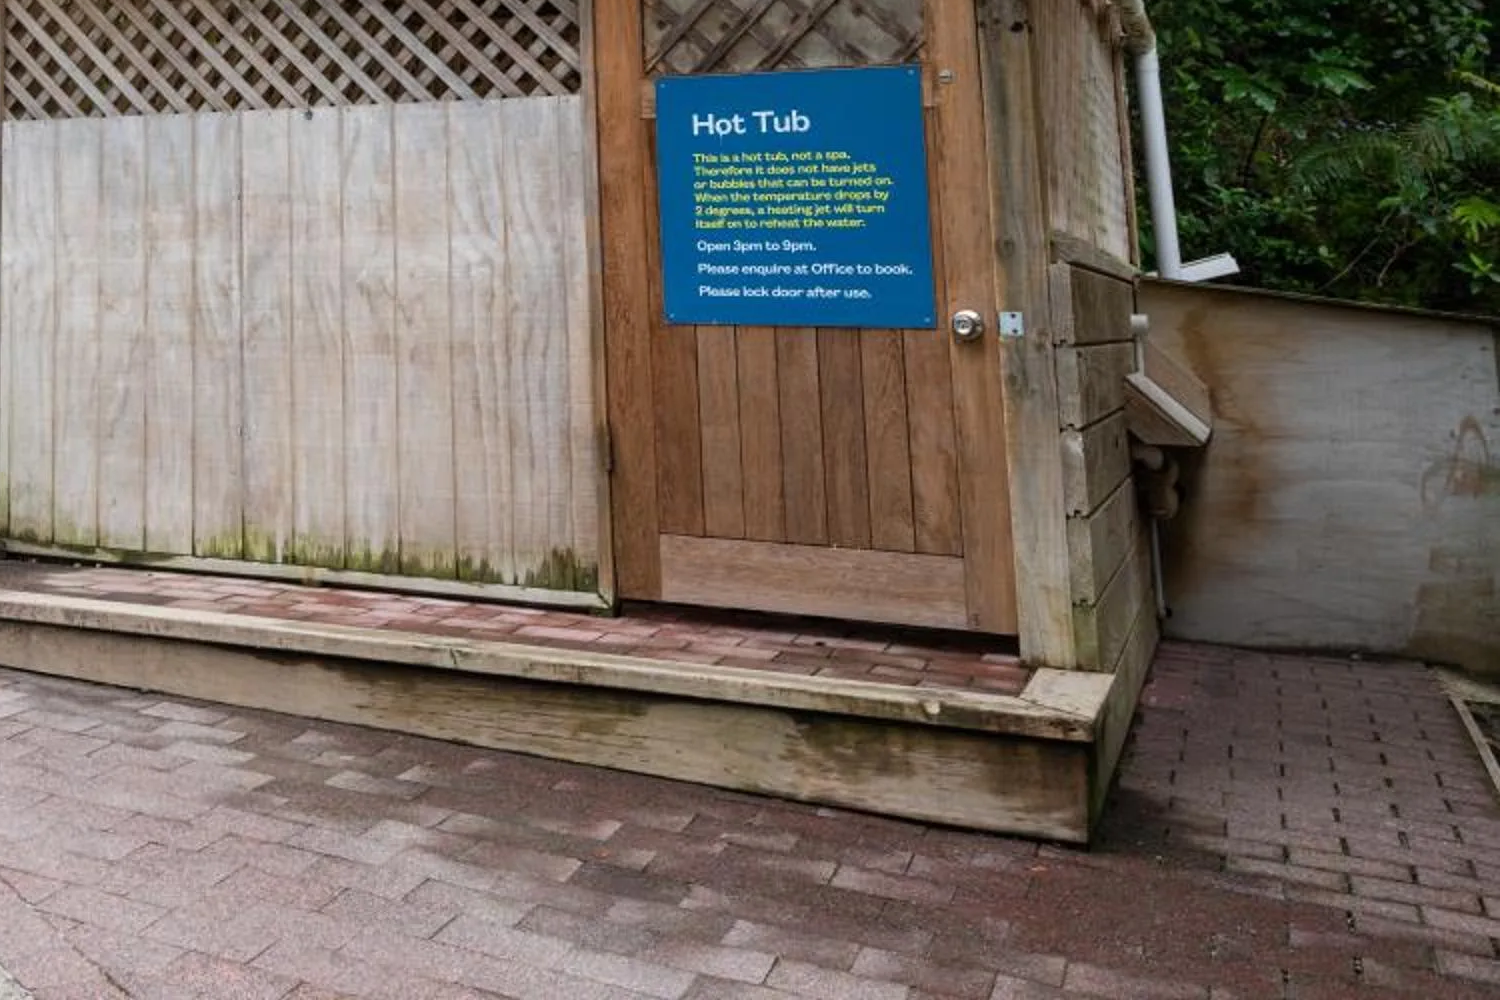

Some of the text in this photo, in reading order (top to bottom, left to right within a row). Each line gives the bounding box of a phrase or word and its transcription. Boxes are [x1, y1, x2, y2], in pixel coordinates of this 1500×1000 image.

[692, 109, 811, 137] Hot Tub
[692, 151, 851, 163] This is a hot tub, not a spa.
[693, 162, 877, 176] Therefore it does not have jets
[709, 179, 756, 189] bubbles
[758, 179, 785, 188] that
[786, 179, 809, 187] can
[811, 177, 827, 187] be
[829, 177, 872, 187] turned
[694, 190, 889, 203] When the temperature drops by
[695, 203, 885, 217] 2 degrees, a heating jet will turn
[727, 220, 743, 228] on
[744, 219, 758, 228] to
[760, 218, 801, 228] reheat
[803, 217, 825, 228] the
[826, 218, 866, 228] water.
[697, 239, 817, 254] Open 3pm to 9pm.
[697, 263, 913, 276] Please enquire at Office to book.
[699, 285, 873, 299] Please lock door after use.
